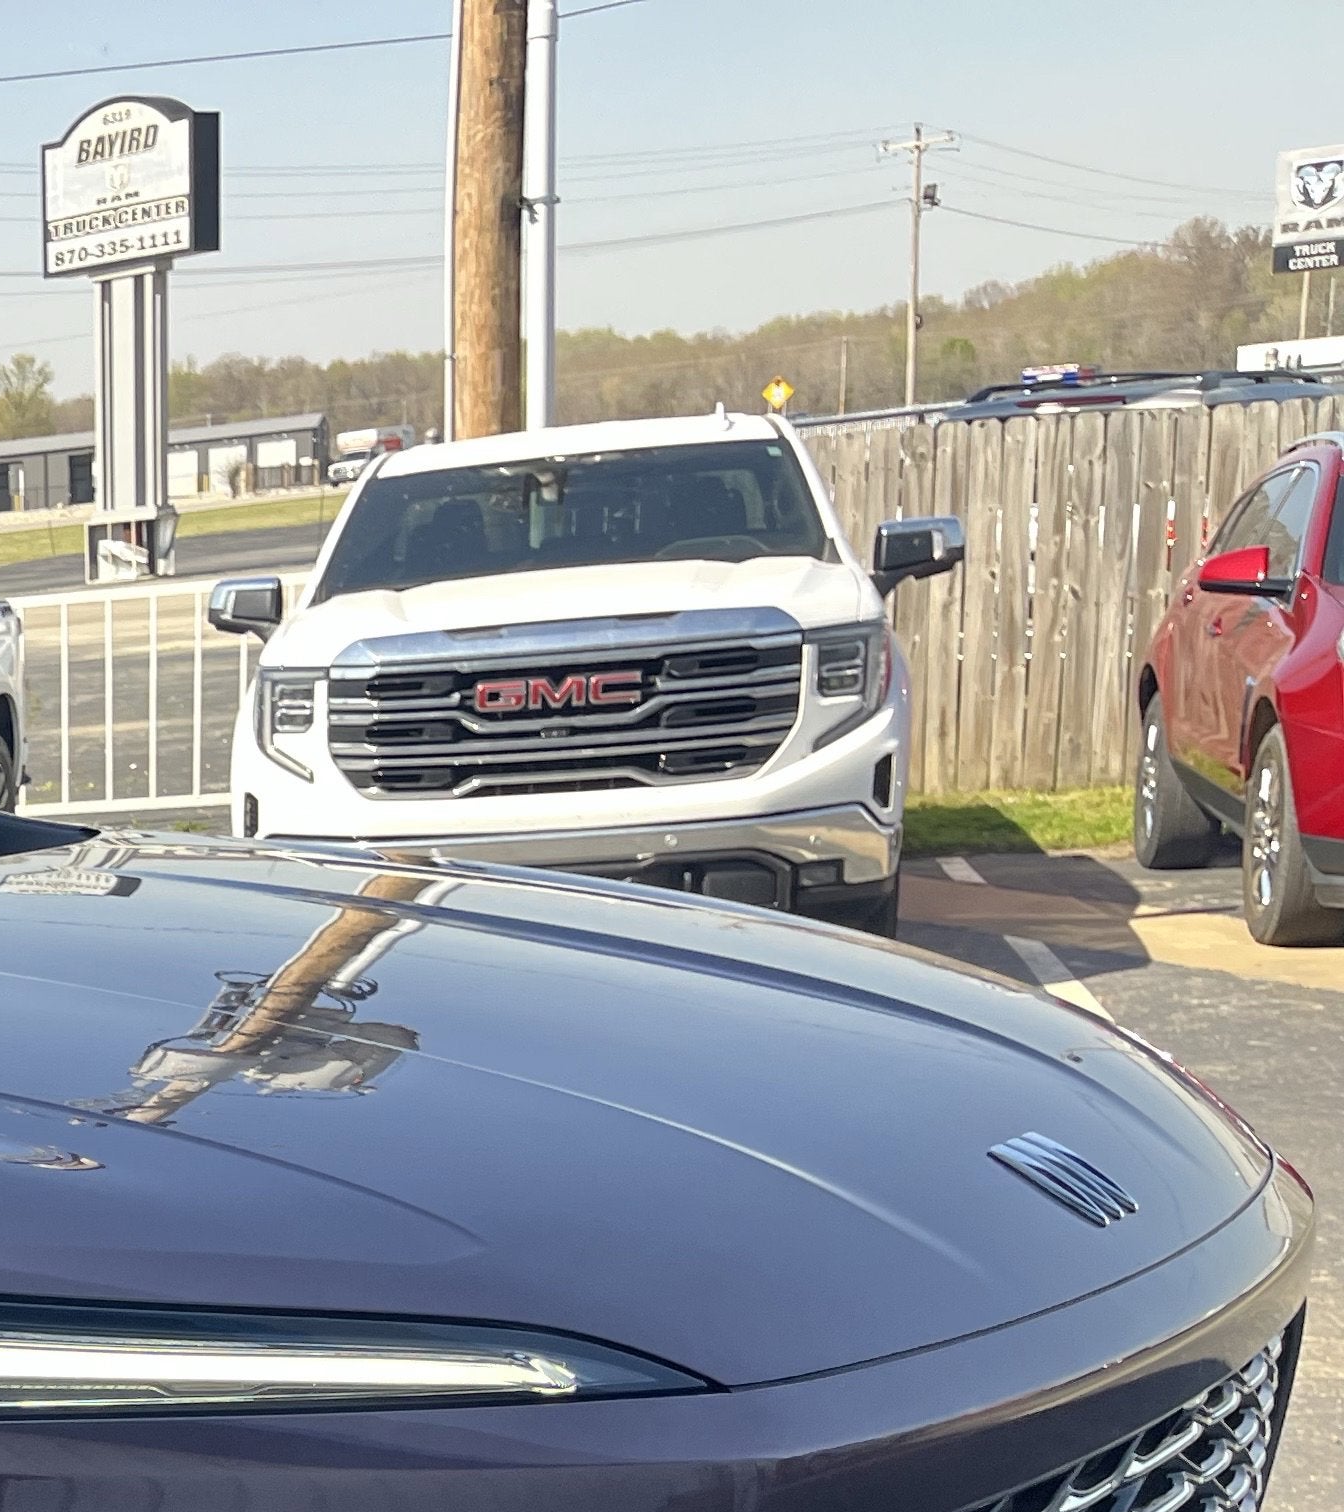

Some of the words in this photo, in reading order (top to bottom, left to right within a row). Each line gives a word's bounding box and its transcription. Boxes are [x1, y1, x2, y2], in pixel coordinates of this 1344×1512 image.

[76, 123, 159, 165] BAYIRD
[52, 213, 112, 238] TRUCK
[118, 199, 185, 225] CENTER
[55, 229, 183, 267] 870-335-1111
[1288, 254, 1340, 271] CENTER
[1293, 241, 1336, 257] TRUCK
[475, 670, 643, 714] GMC
